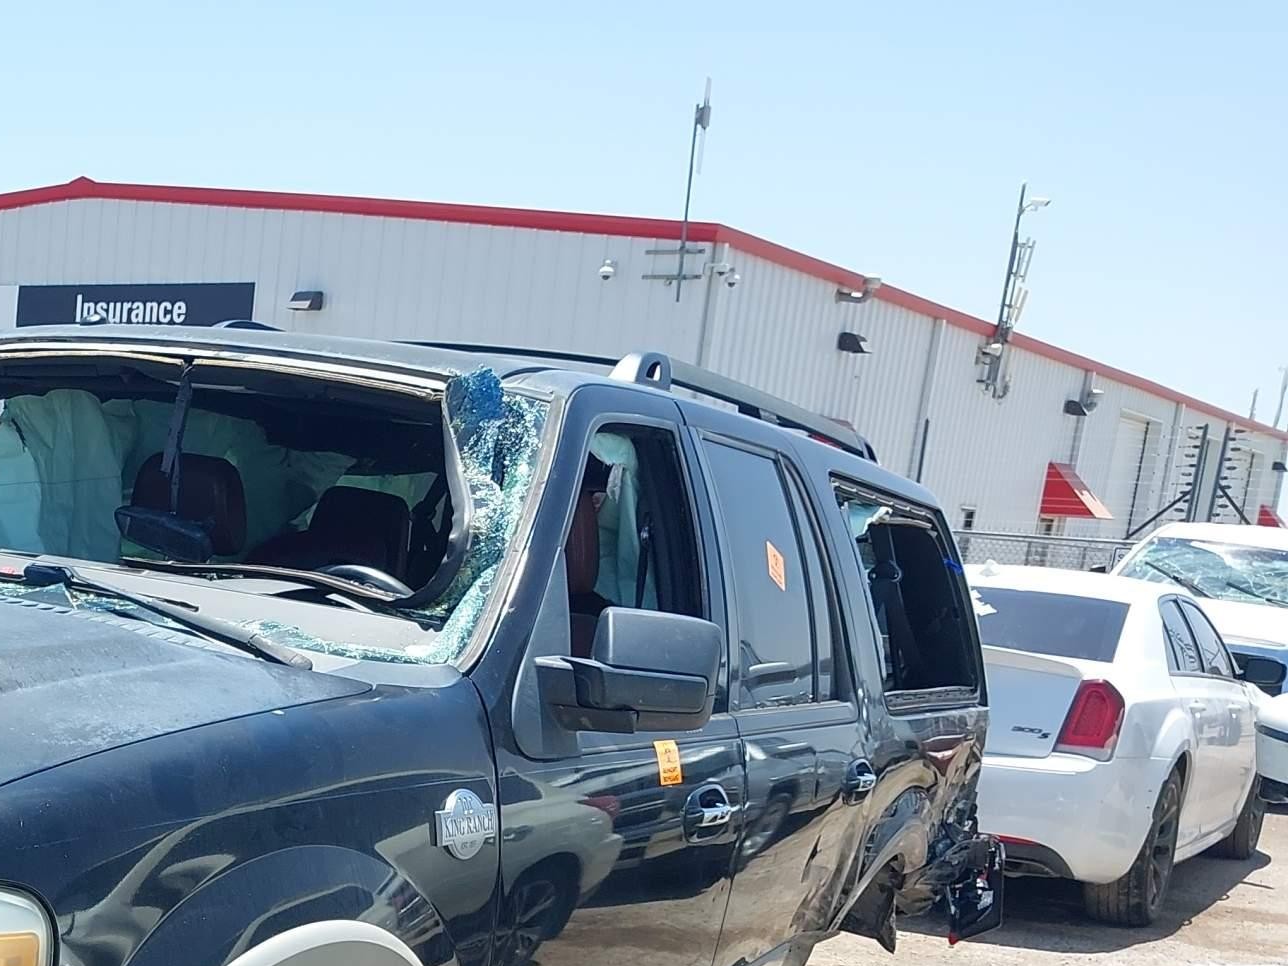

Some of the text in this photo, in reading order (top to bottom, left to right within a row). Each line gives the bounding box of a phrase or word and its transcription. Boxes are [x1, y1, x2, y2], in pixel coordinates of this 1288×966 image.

[75, 294, 187, 323] Insurance
[443, 809, 493, 839] KING RANCH
